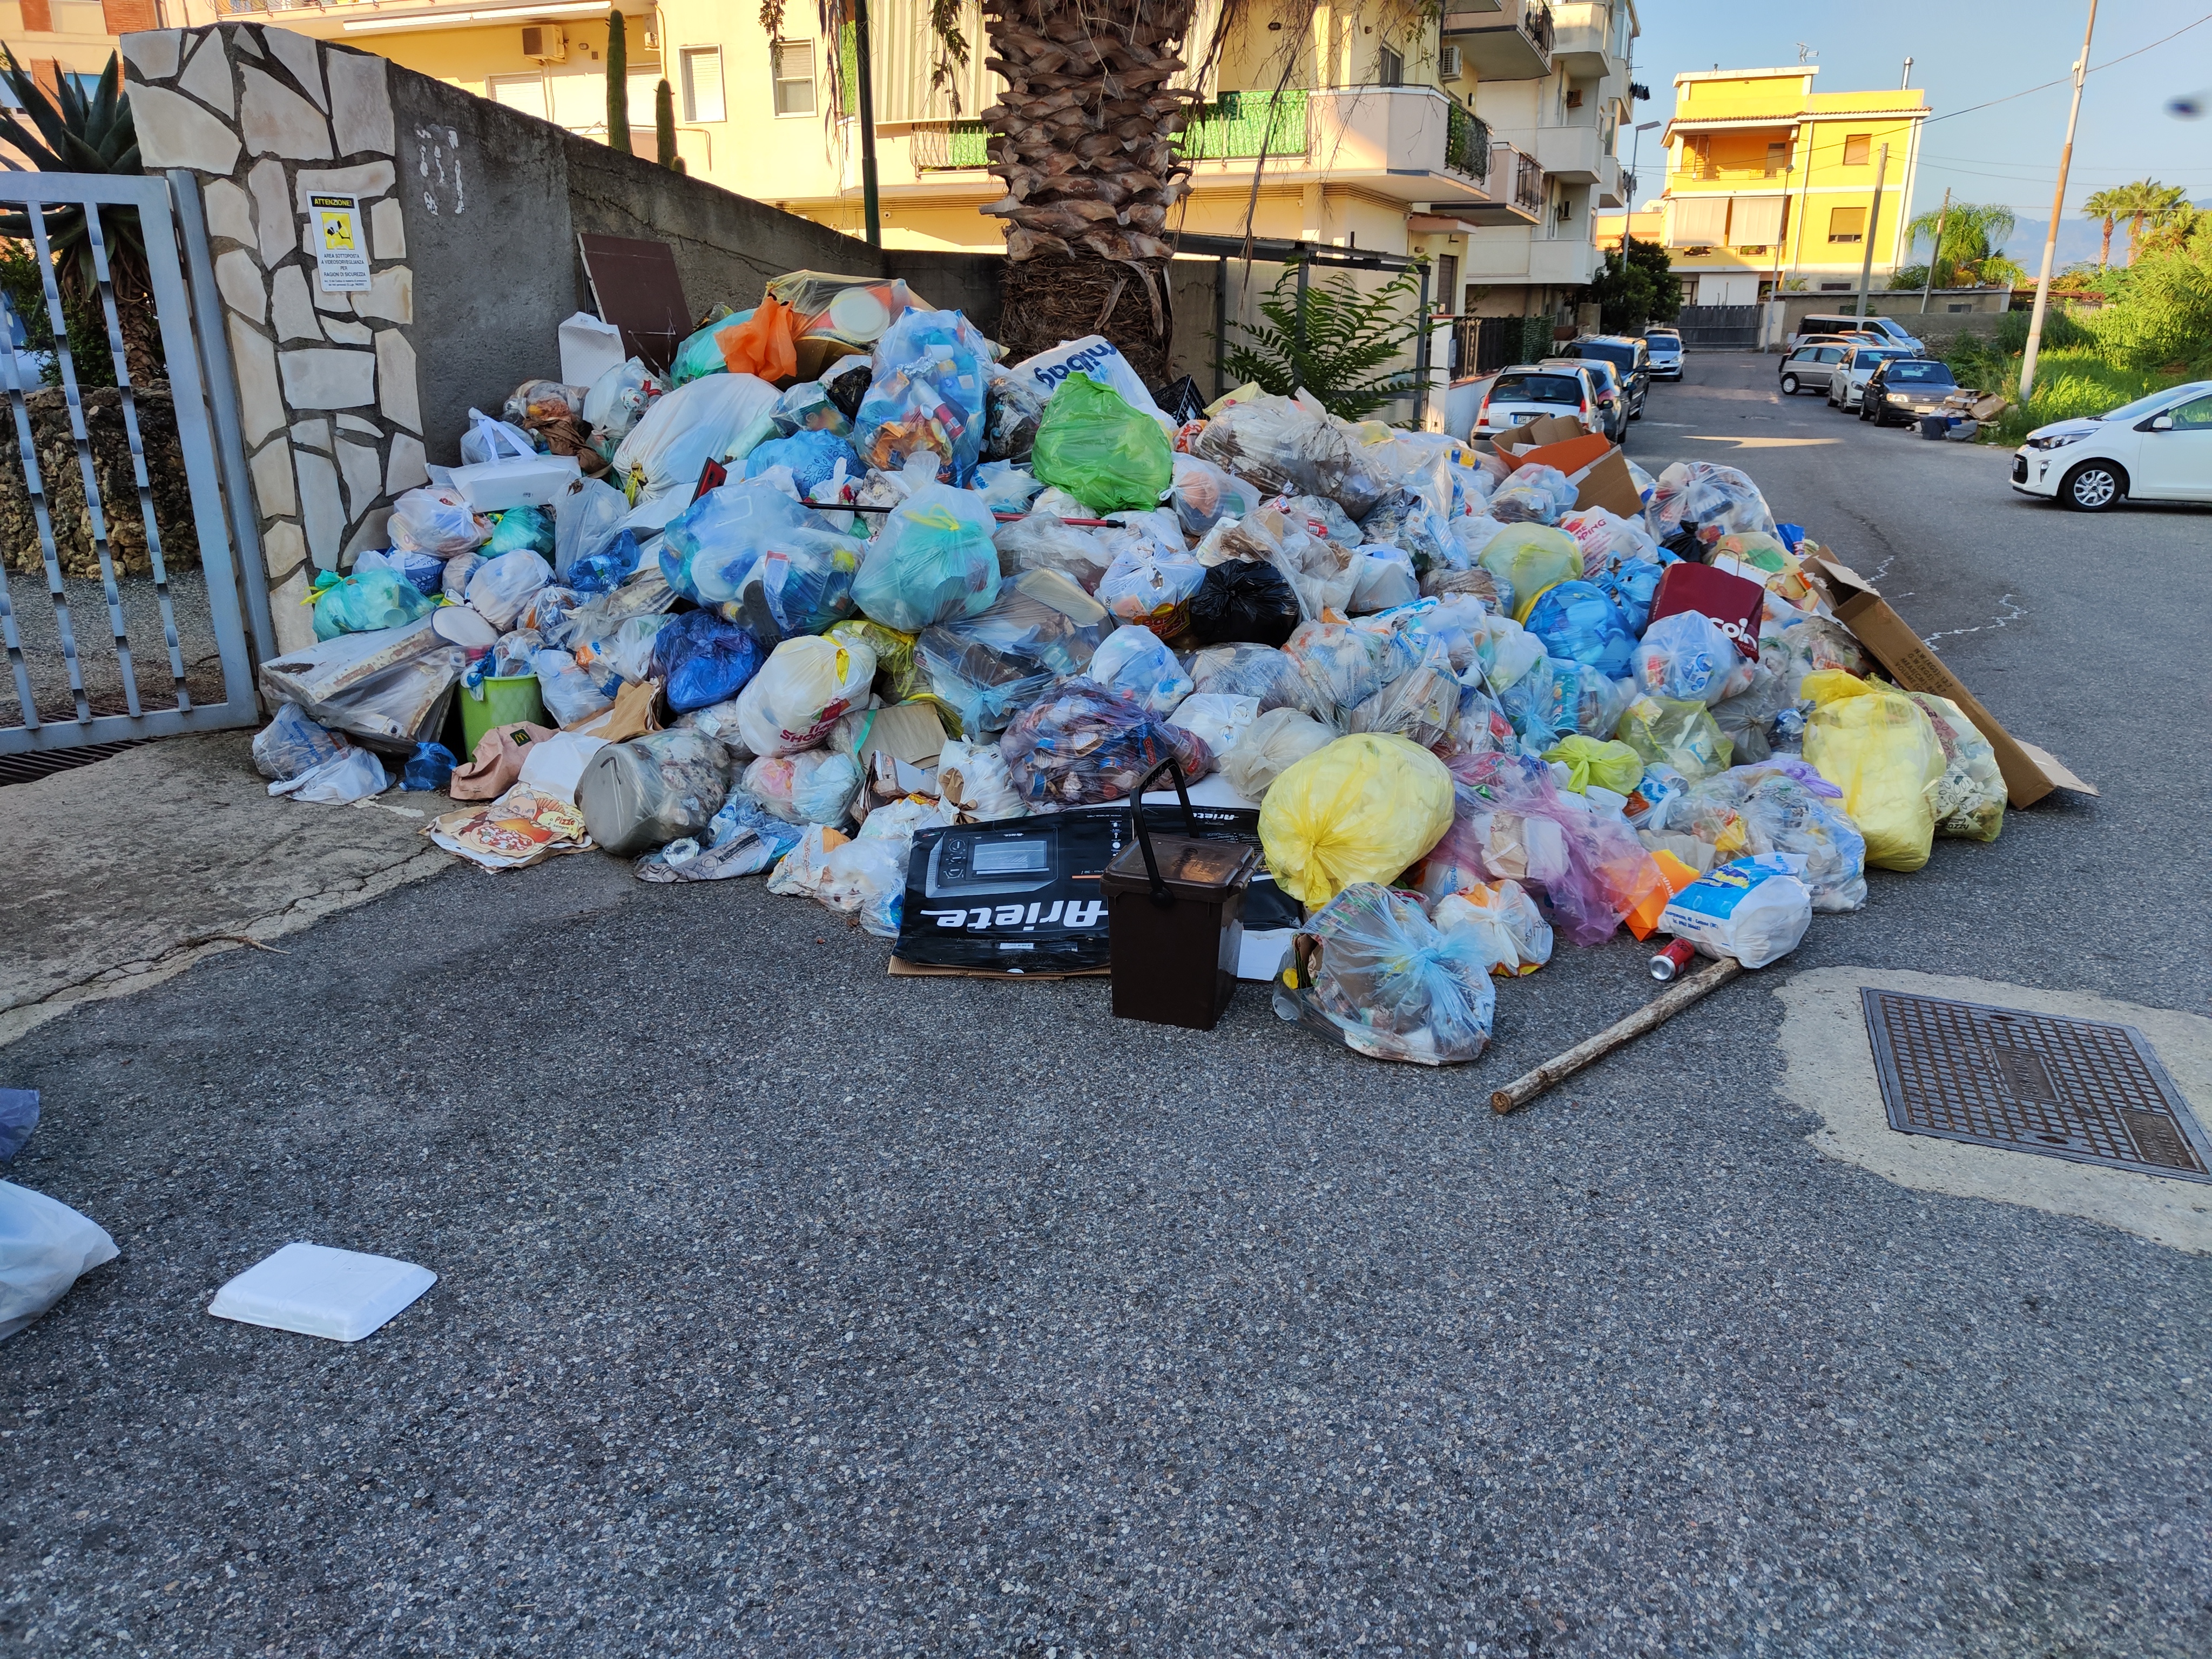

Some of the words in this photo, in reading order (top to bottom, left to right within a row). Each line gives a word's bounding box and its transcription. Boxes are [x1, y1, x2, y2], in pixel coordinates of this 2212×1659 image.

[314, 198, 353, 207] ATTENZIONE!
[1895, 662, 1916, 684] VOLUME
[920, 900, 1108, 932] Ariete
[2008, 1053, 2041, 1097] FOGNATURA
